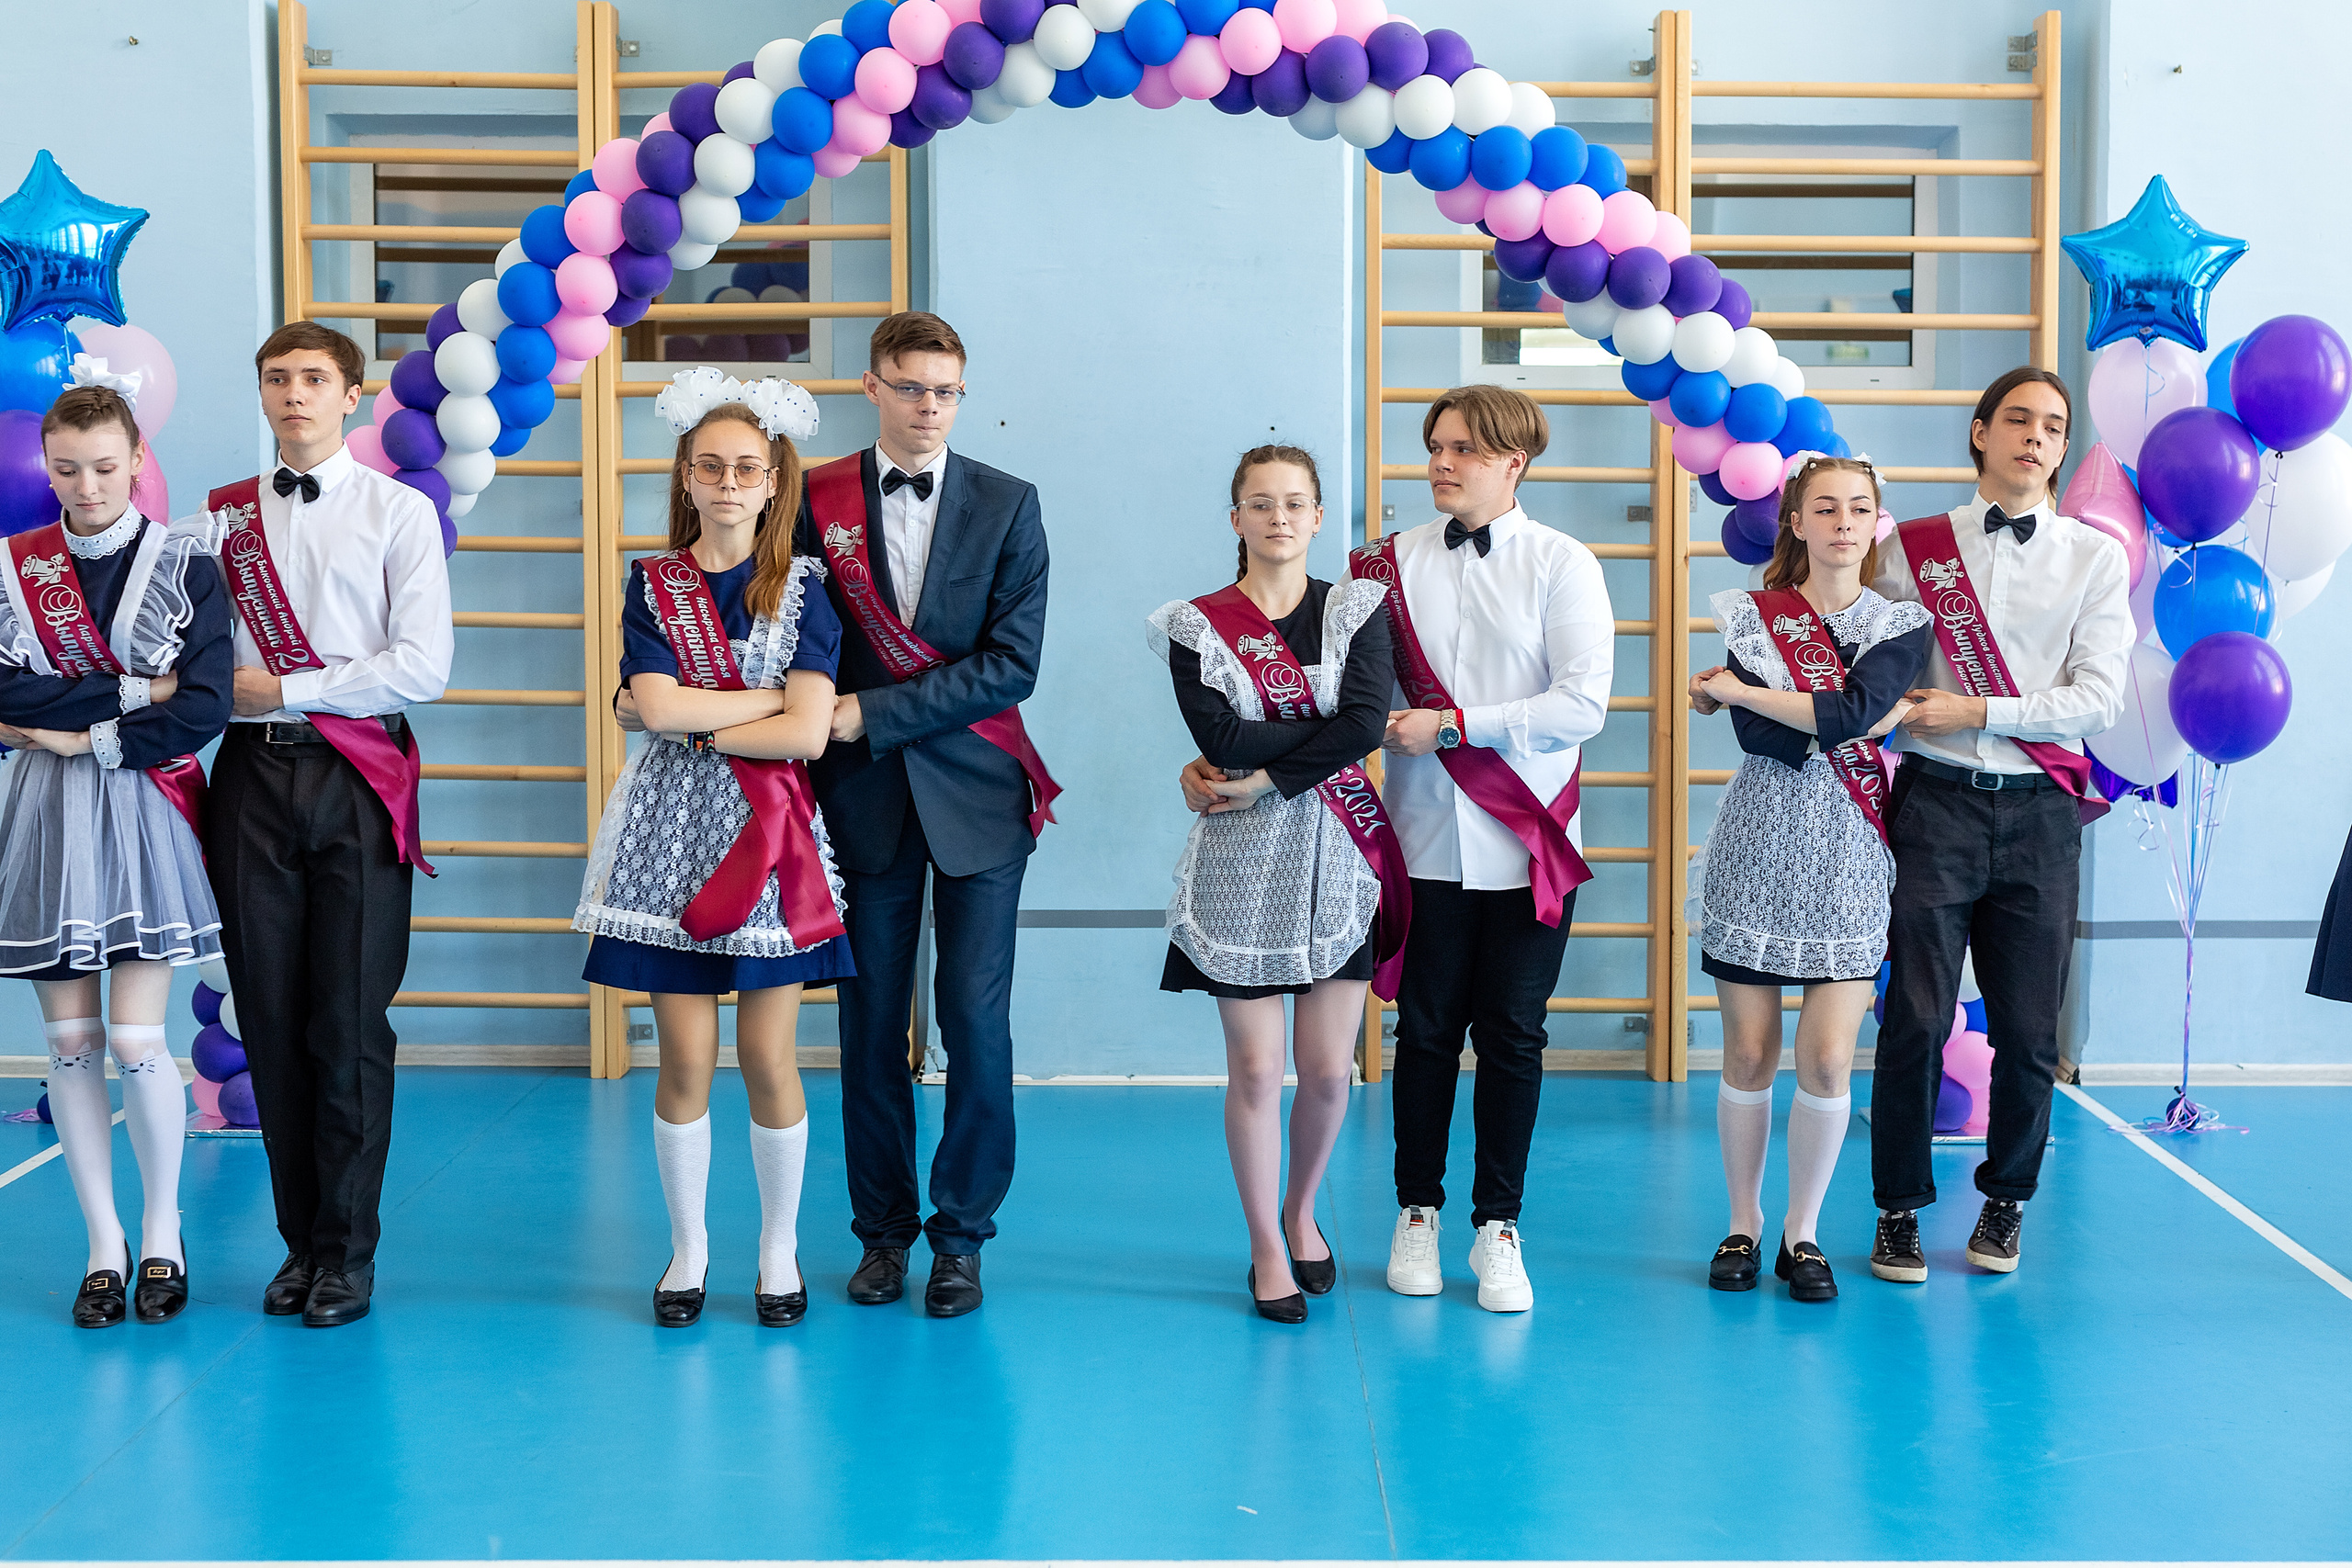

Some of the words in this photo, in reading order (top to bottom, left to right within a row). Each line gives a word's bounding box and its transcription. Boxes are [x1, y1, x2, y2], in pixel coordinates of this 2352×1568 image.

[230, 529, 283, 649] Выпускник
[256, 559, 286, 610] Быковский
[277, 611, 302, 646] Андрей
[839, 557, 918, 672] Выпускник
[77, 624, 104, 660] Ларина
[658, 559, 719, 689] Выпускница
[670, 626, 683, 645] МБОУ
[676, 645, 687, 661] СОШ
[696, 596, 719, 644] Насырова
[712, 646, 731, 678] Софья
[899, 633, 933, 662] Владислав
[1936, 590, 1995, 697] Выпускни
[1955, 663, 1970, 682] МБОУ
[1971, 623, 1989, 652] Гудков
[1985, 653, 2011, 697] Констант
[1855, 740, 1873, 761] арья
[1332, 777, 1385, 838] 2021
